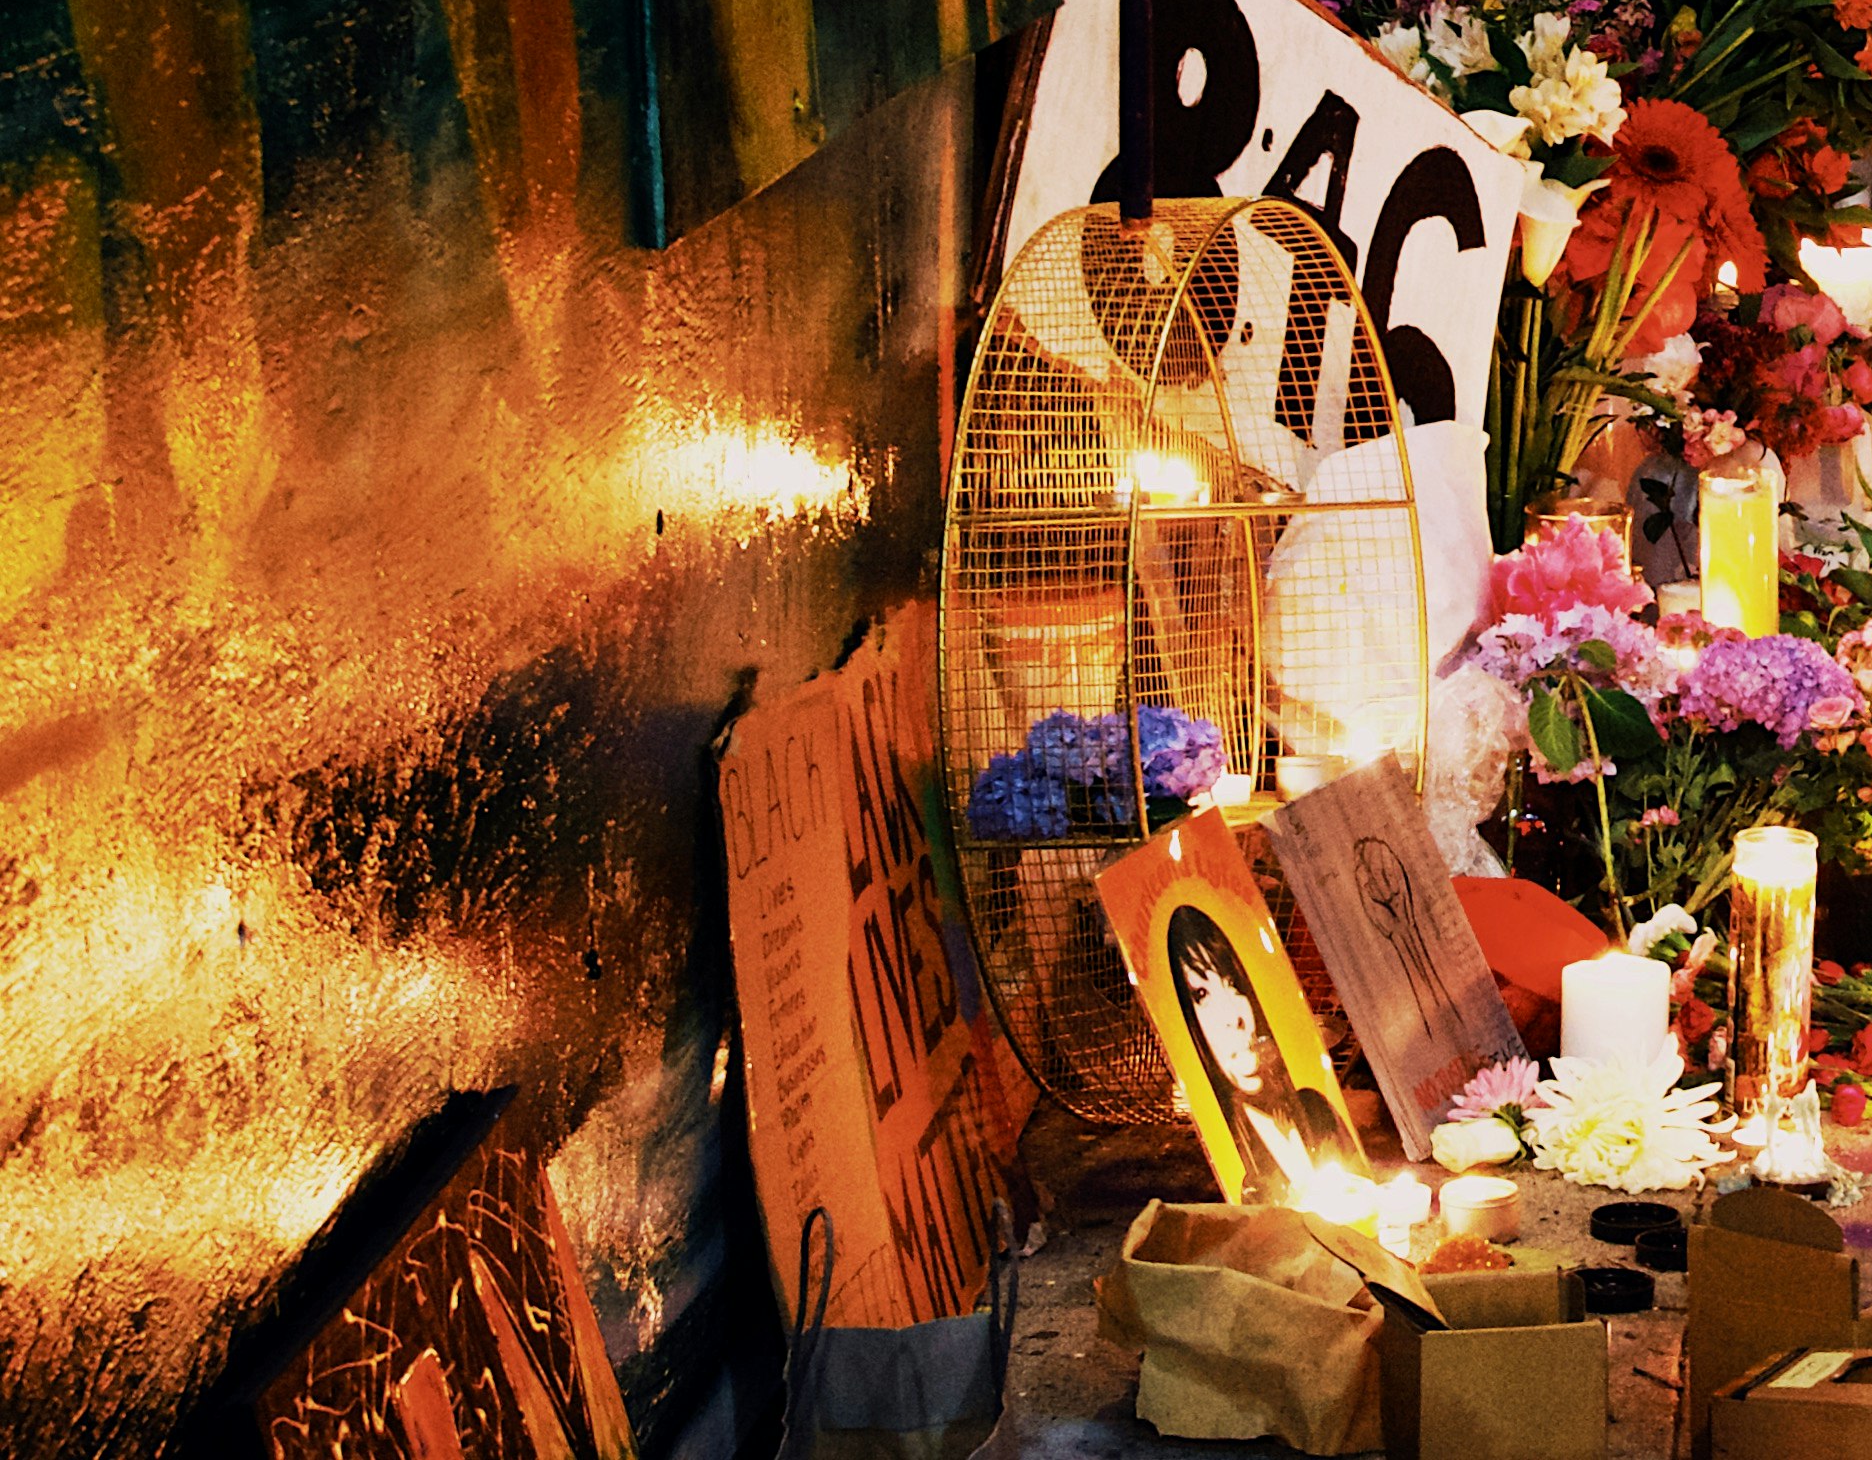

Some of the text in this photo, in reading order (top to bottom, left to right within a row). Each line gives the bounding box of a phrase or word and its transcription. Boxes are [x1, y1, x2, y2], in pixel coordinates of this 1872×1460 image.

[725, 732, 827, 880] BLACK
[758, 873, 795, 922] Lives
[847, 852, 957, 1122] LIVES
